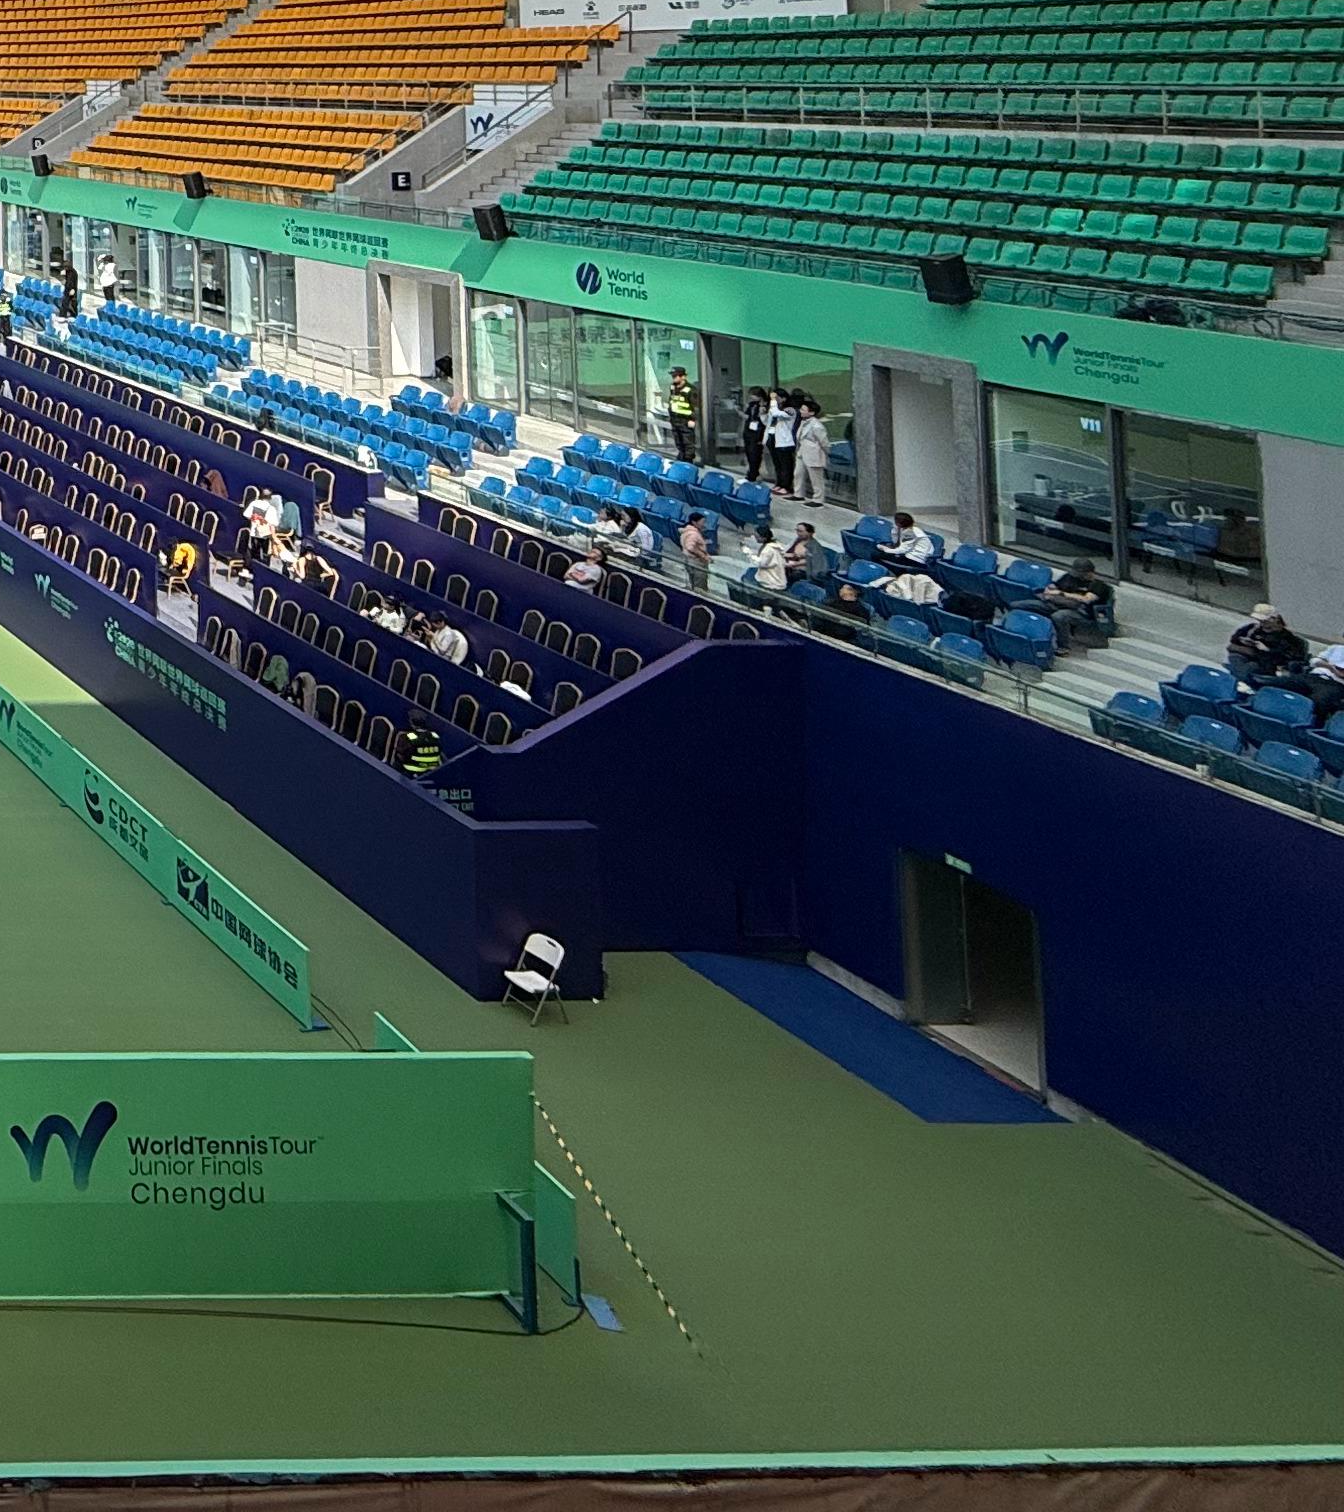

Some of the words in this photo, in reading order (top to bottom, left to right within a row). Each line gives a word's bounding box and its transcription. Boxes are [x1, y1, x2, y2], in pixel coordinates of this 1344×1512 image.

[534, 8, 565, 16] HEAD
[605, 266, 645, 286] World
[607, 281, 649, 301] Tennis
[1072, 346, 1167, 369] WorldTennisTour
[1073, 356, 1105, 368] Junior
[1073, 365, 1140, 385] Chengdu
[108, 797, 149, 842] CDCT
[211, 896, 299, 991] 中国网球协会
[127, 1135, 318, 1156] WorldTennisTour
[128, 1156, 196, 1176] Junior
[201, 1156, 263, 1176] Finals
[130, 1181, 265, 1211] Chengdu
